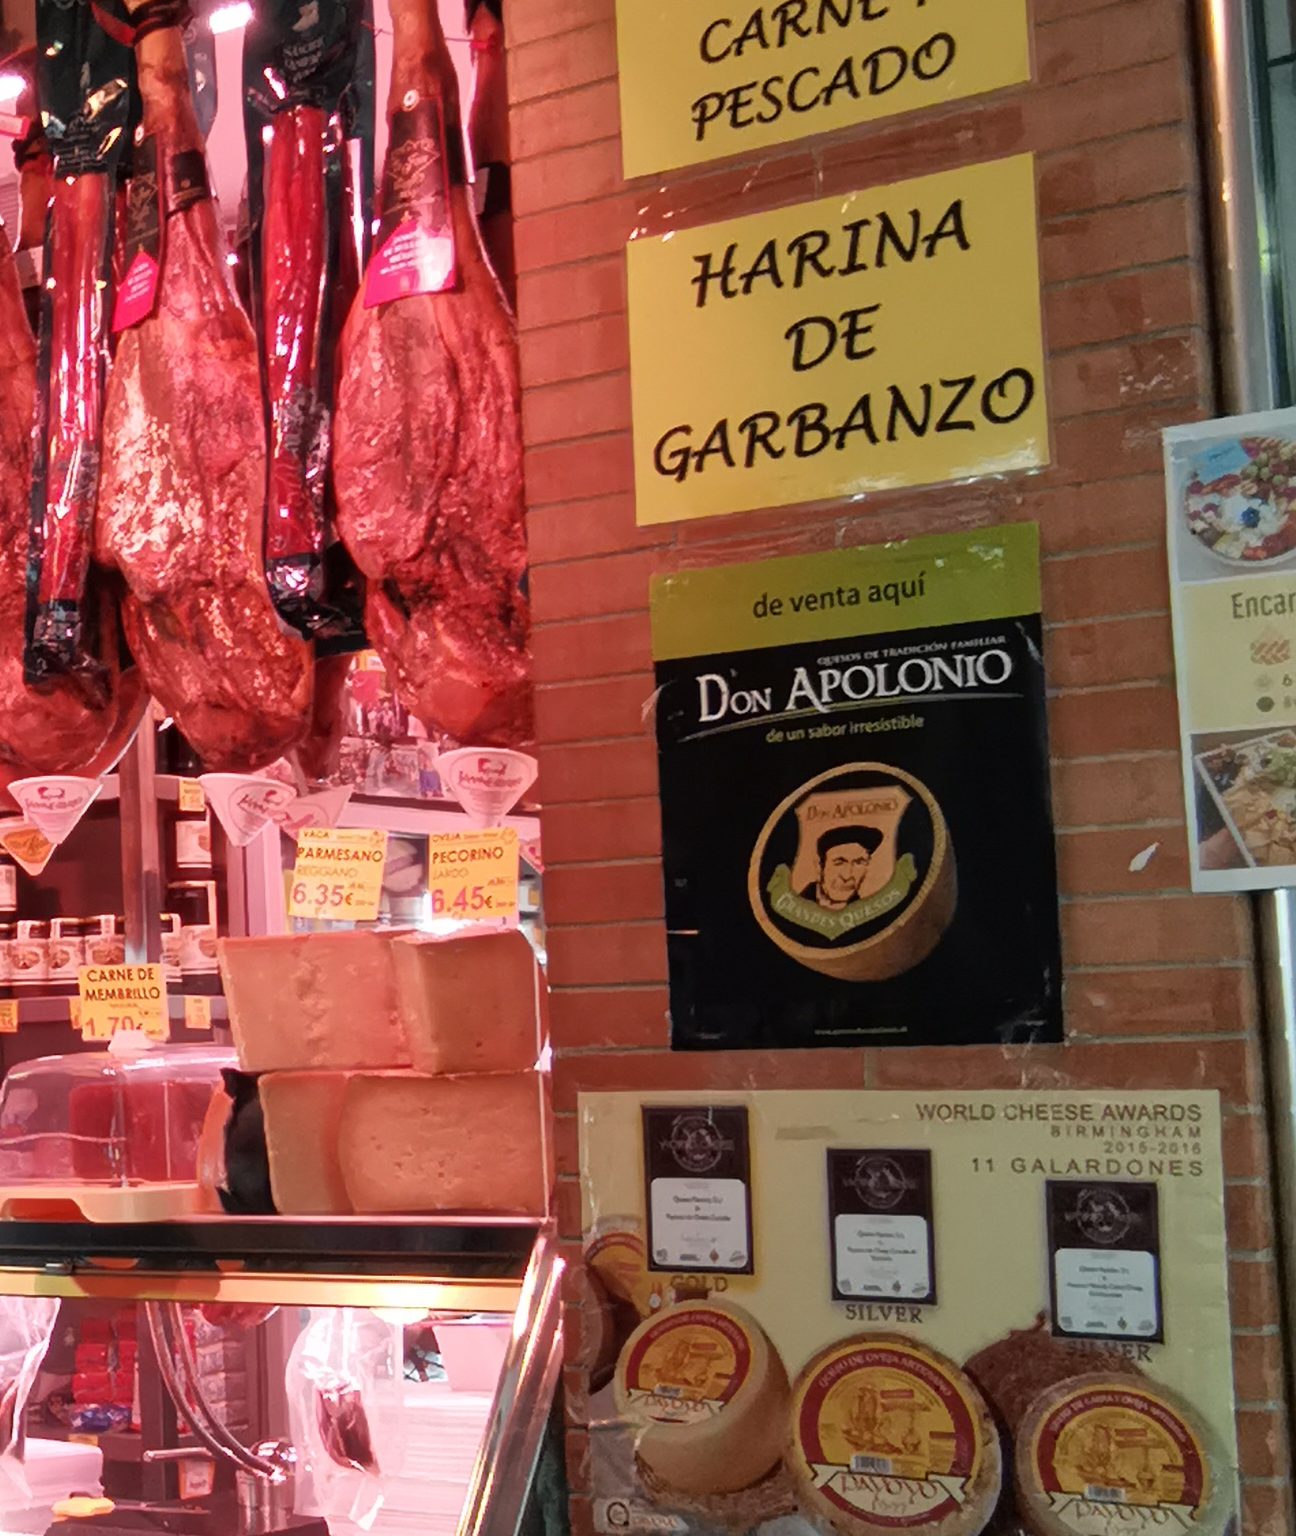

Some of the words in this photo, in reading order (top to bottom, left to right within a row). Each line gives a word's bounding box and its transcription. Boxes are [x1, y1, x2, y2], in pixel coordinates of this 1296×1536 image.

[691, 31, 957, 142] PESCADO
[691, 199, 970, 308] HARINA
[785, 303, 882, 372] DE
[654, 367, 1035, 483] GARBANZO
[752, 592, 783, 619] de
[789, 584, 861, 613] venta
[867, 572, 927, 608] aquí
[864, 649, 880, 660] DE
[766, 727, 785, 743] de
[786, 725, 806, 740] un
[808, 720, 847, 739] sabor
[849, 714, 925, 734] irresistible
[303, 830, 329, 840] VACA
[297, 847, 384, 862] PARMESANO
[432, 846, 504, 864] PECORINO
[87, 968, 133, 982] CARNE
[137, 967, 154, 980] DE
[84, 986, 160, 1001] MEMBRILLO
[916, 1104, 995, 1122] WORLD
[1004, 1104, 1094, 1122] CHEESE
[1102, 1104, 1202, 1122] AWARDS
[1050, 1124, 1202, 1139] BIRMINGHAM
[972, 1157, 995, 1173] 11
[1011, 1157, 1204, 1176] GALARDONES
[845, 1304, 923, 1324] SILVER
